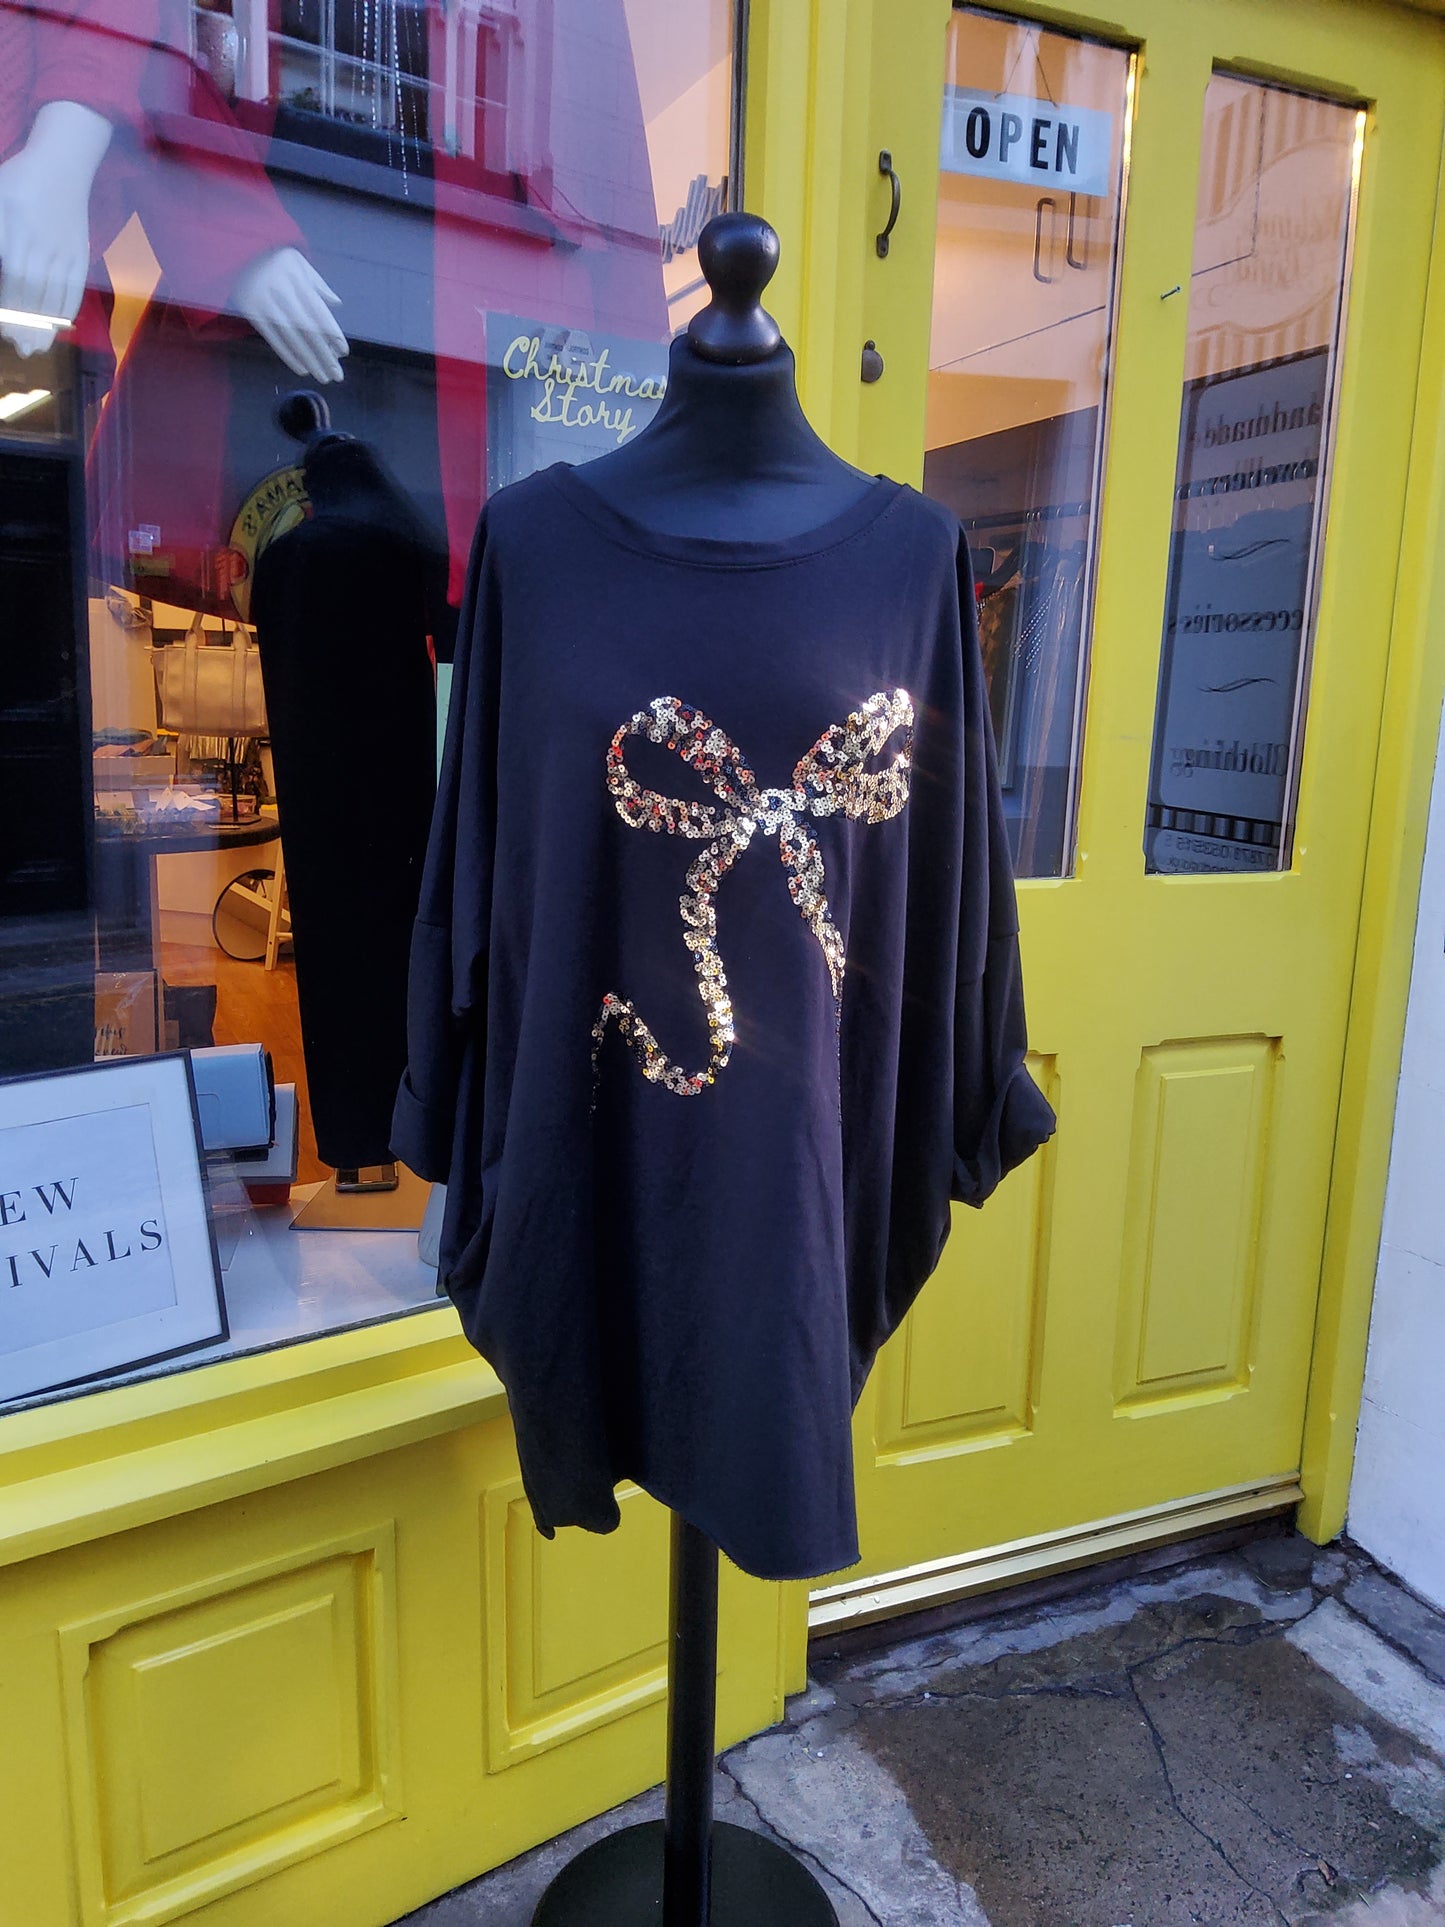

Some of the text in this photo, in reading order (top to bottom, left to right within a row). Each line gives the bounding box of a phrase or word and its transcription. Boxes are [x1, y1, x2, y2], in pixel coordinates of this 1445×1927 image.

[966, 106, 1079, 174] OPEN
[531, 378, 636, 444] Story
[0, 1177, 79, 1226] EW
[5, 1219, 162, 1288] IVALS
